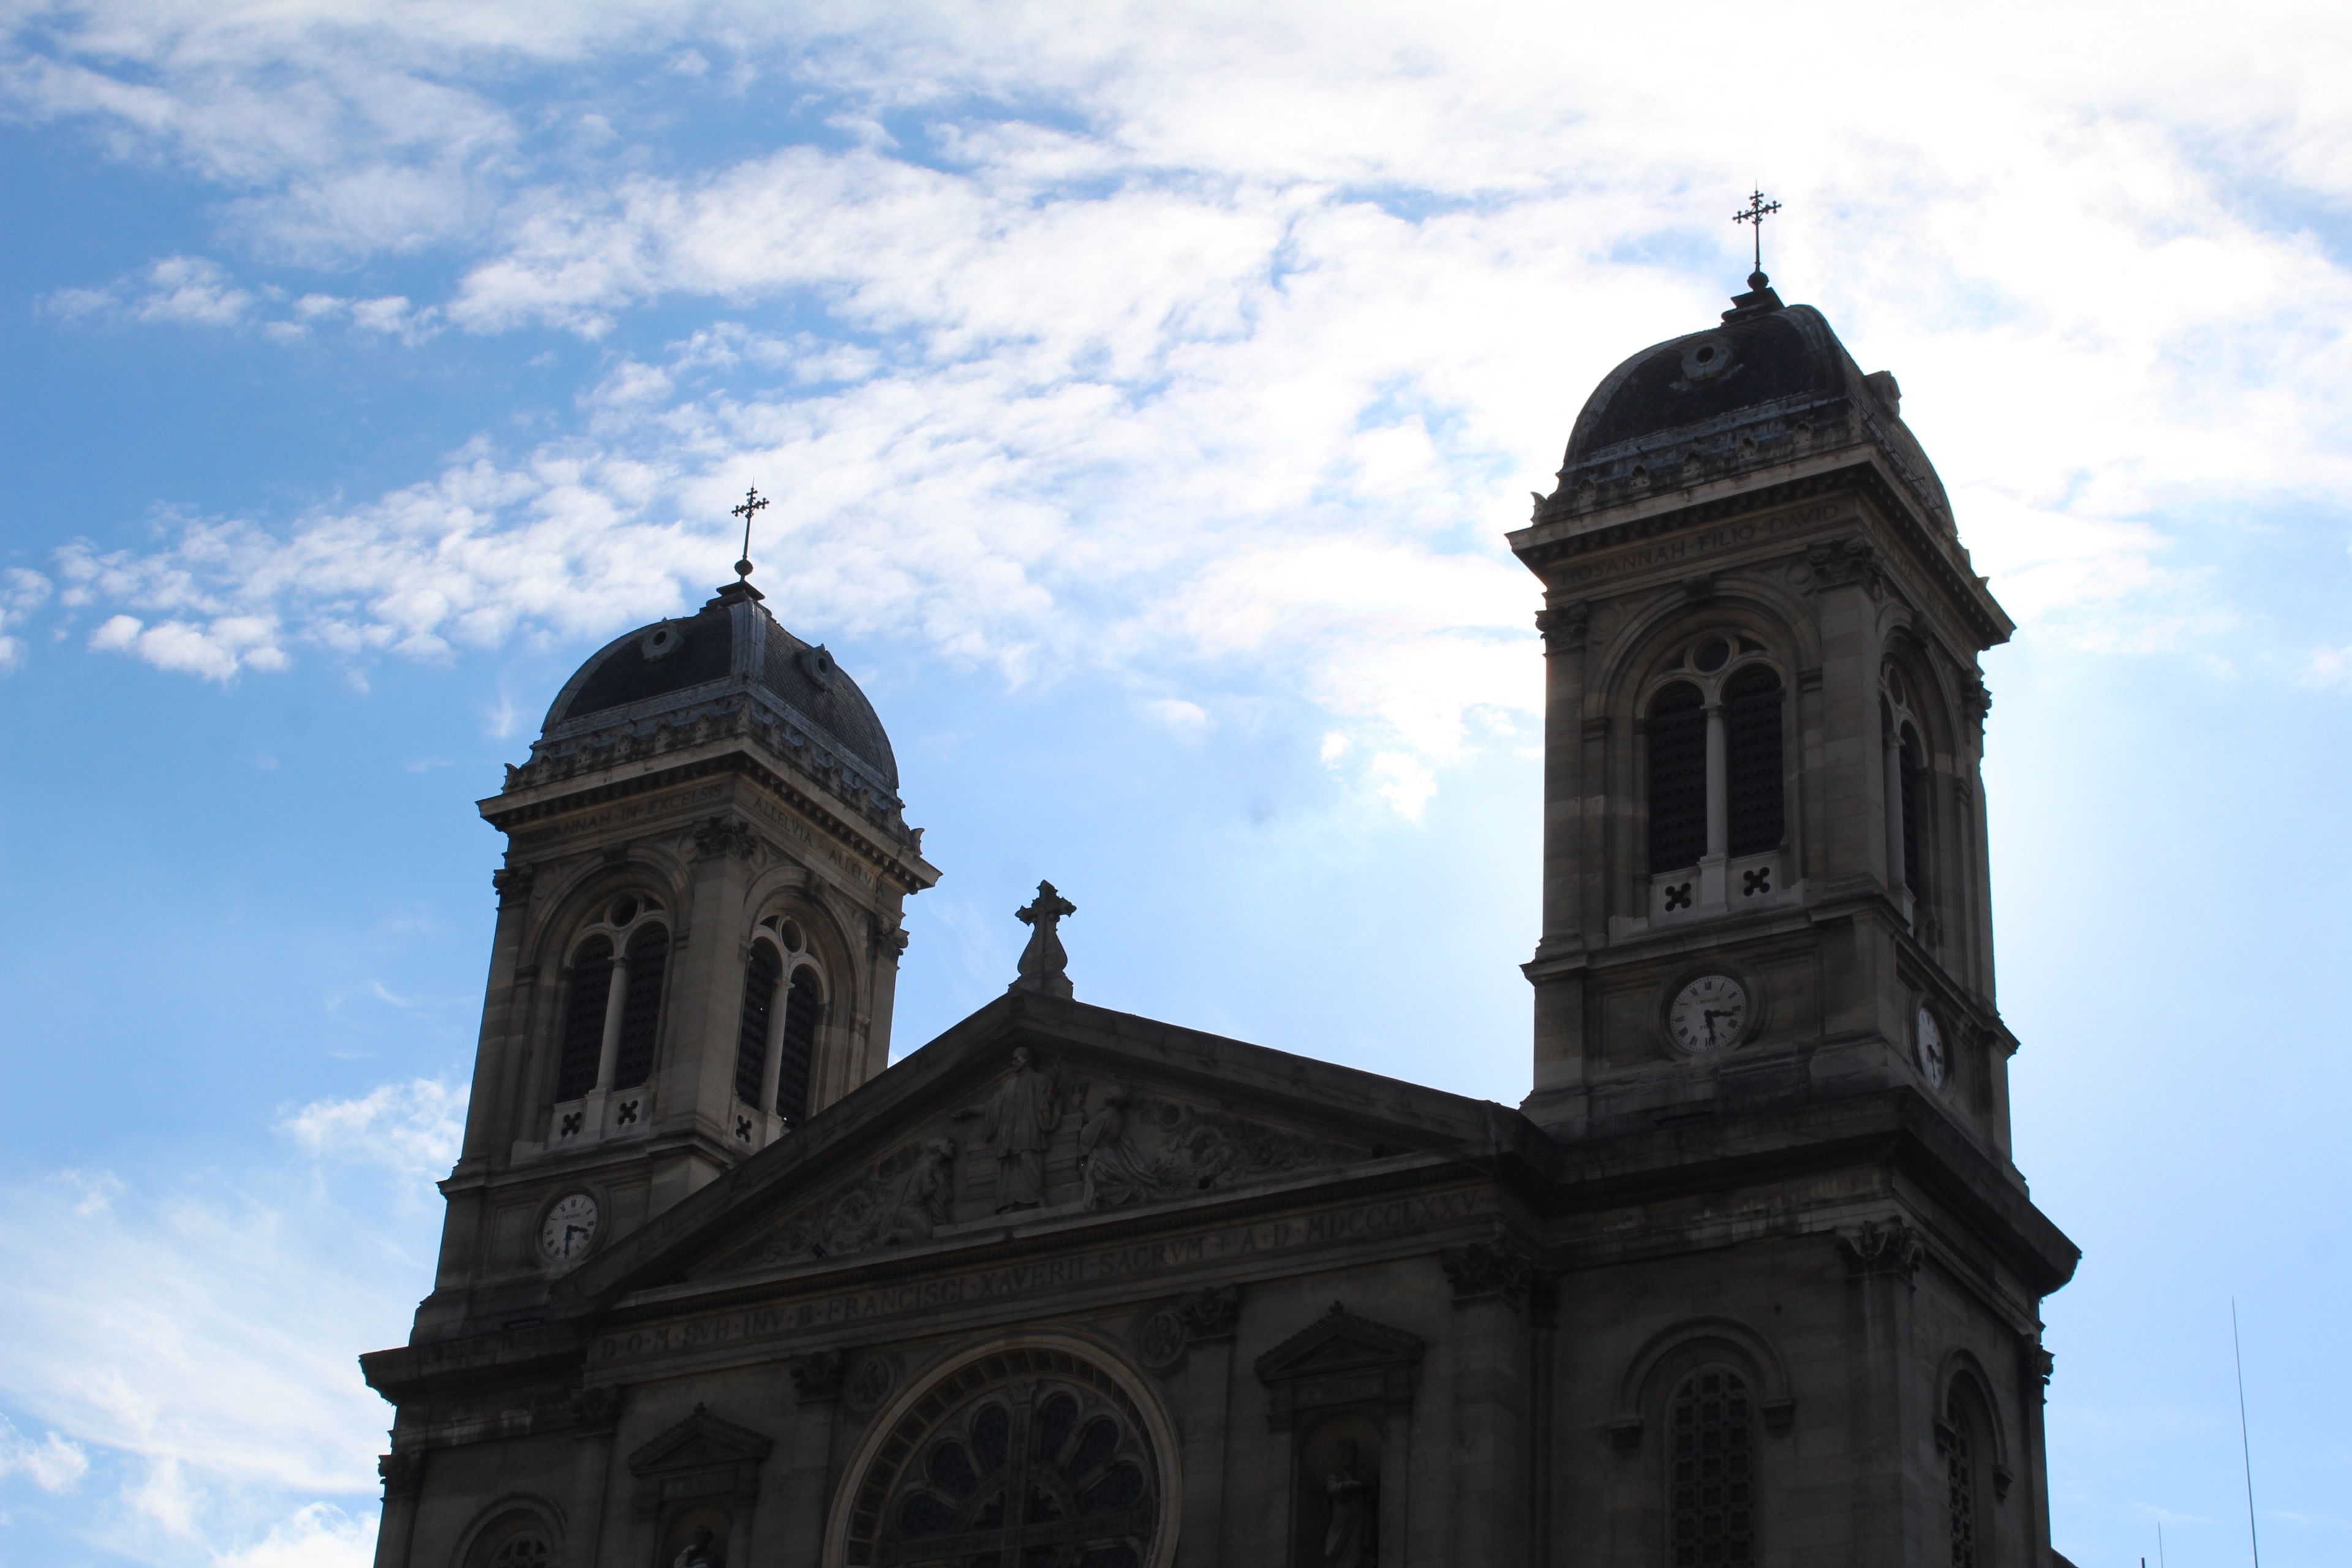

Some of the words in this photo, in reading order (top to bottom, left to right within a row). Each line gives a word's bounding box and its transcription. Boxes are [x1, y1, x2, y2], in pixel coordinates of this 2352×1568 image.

[1561, 540, 1685, 585] HOSANNAH
[1699, 522, 1755, 551] FILIO
[1770, 503, 1838, 534] DAVID
[620, 804, 638, 821] IN
[649, 783, 722, 814] EXCELSIS
[753, 795, 813, 848] ALLELVIA
[682, 1317, 728, 1346] SVB
[743, 1308, 785, 1335] INV
[827, 1277, 965, 1322] FRANCISCI
[979, 1256, 1085, 1297] XAVERII
[1099, 1237, 1204, 1276] SACRVM
[1306, 1188, 1478, 1242] MDCCCLXXV
